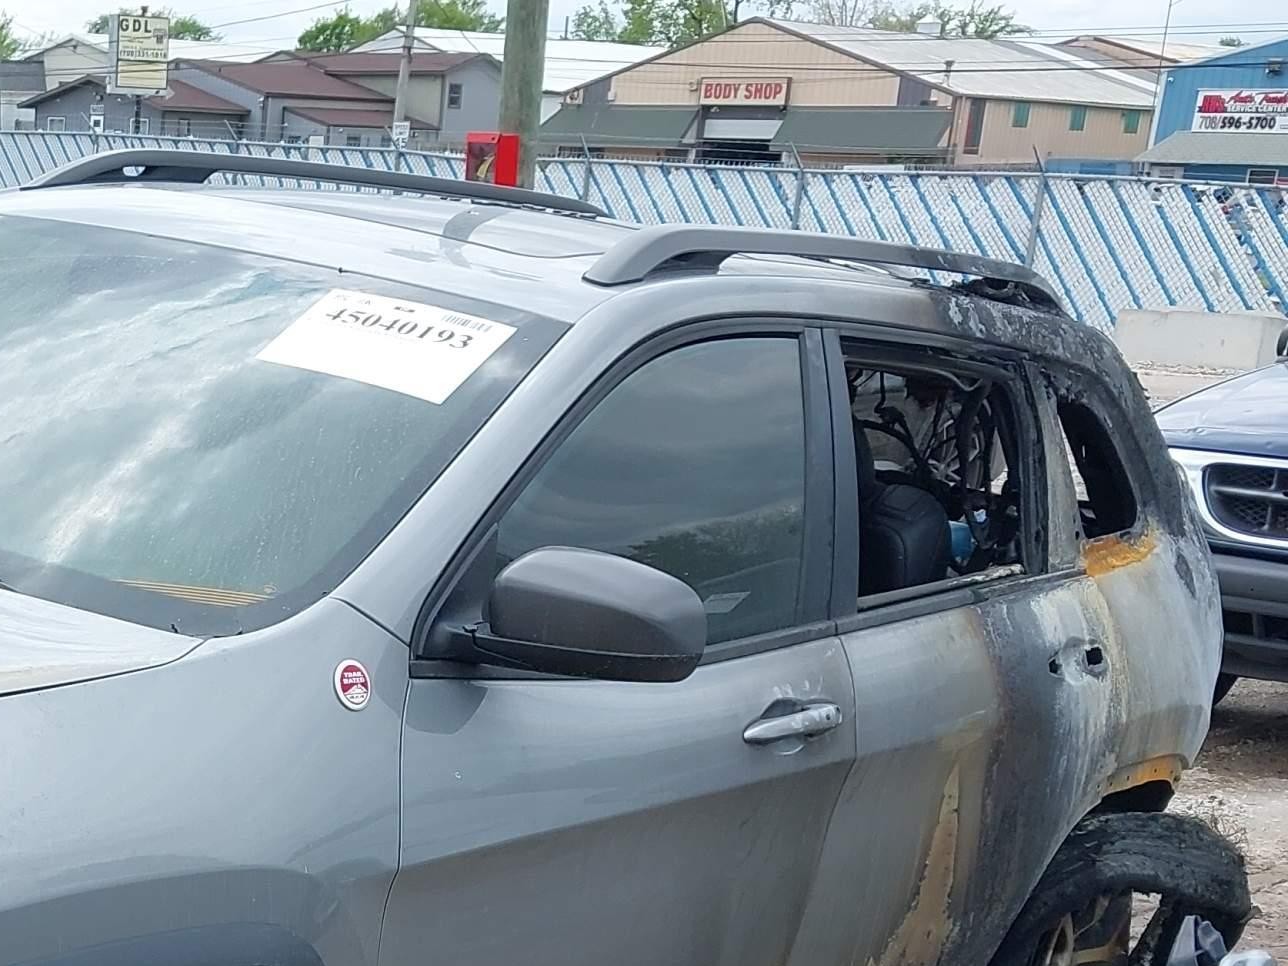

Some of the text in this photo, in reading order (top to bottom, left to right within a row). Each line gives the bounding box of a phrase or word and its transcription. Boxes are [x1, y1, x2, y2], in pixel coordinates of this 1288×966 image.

[704, 83, 783, 100] BODY SHOP
[1199, 115, 1277, 130] 708/596-5700
[326, 307, 474, 349] 45040193
